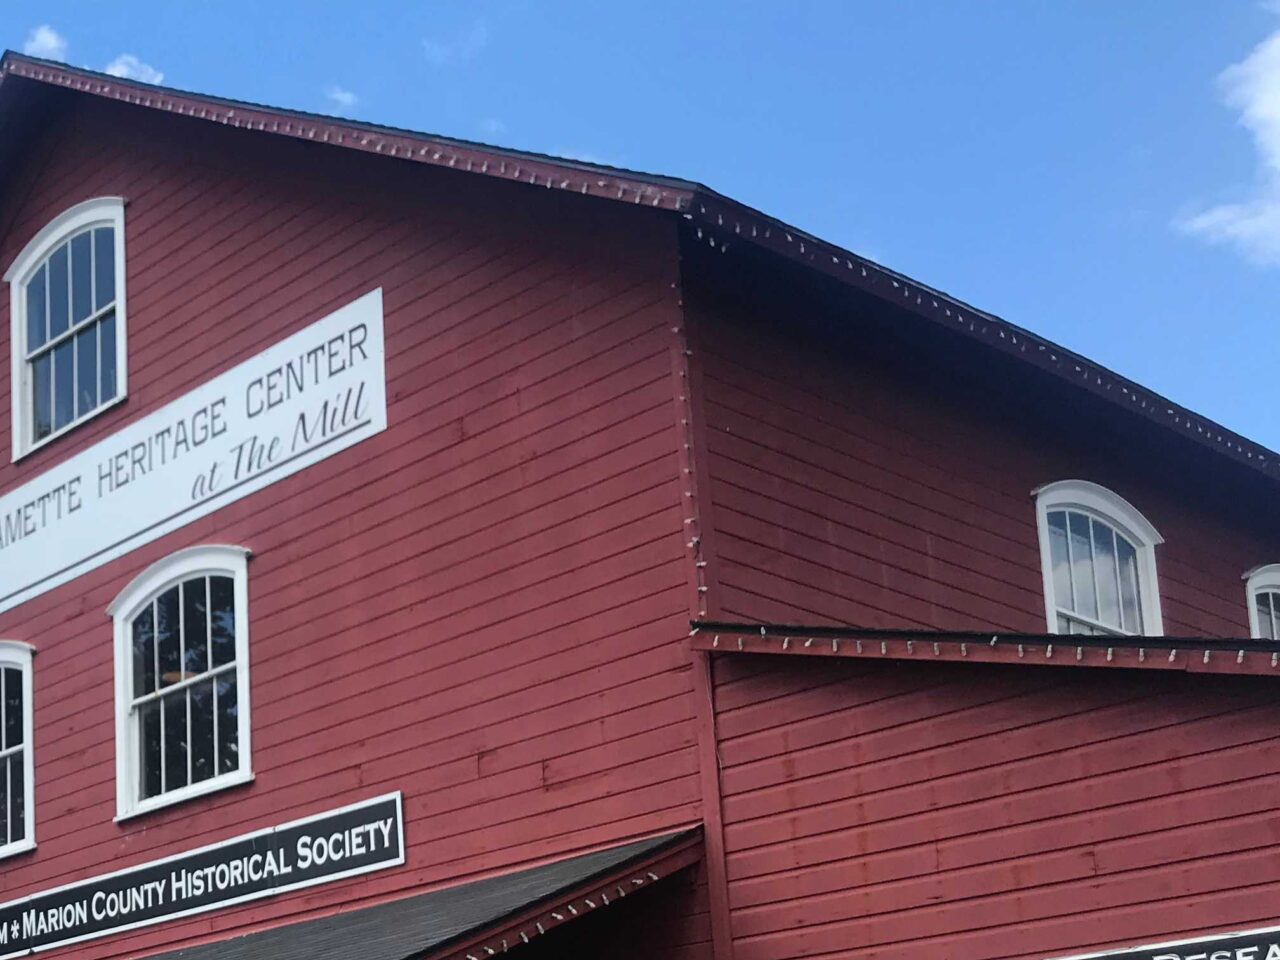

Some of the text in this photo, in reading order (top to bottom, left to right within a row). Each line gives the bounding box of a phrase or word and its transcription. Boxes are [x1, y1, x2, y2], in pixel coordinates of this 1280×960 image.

[97, 396, 227, 498] HERITAGE
[246, 322, 368, 419] CENTER
[191, 381, 369, 500] at The Mill
[22, 900, 87, 939] MARION
[91, 879, 166, 920] COUNTY
[171, 848, 292, 901] HISTORICAL
[296, 817, 393, 869] SOCIETY
